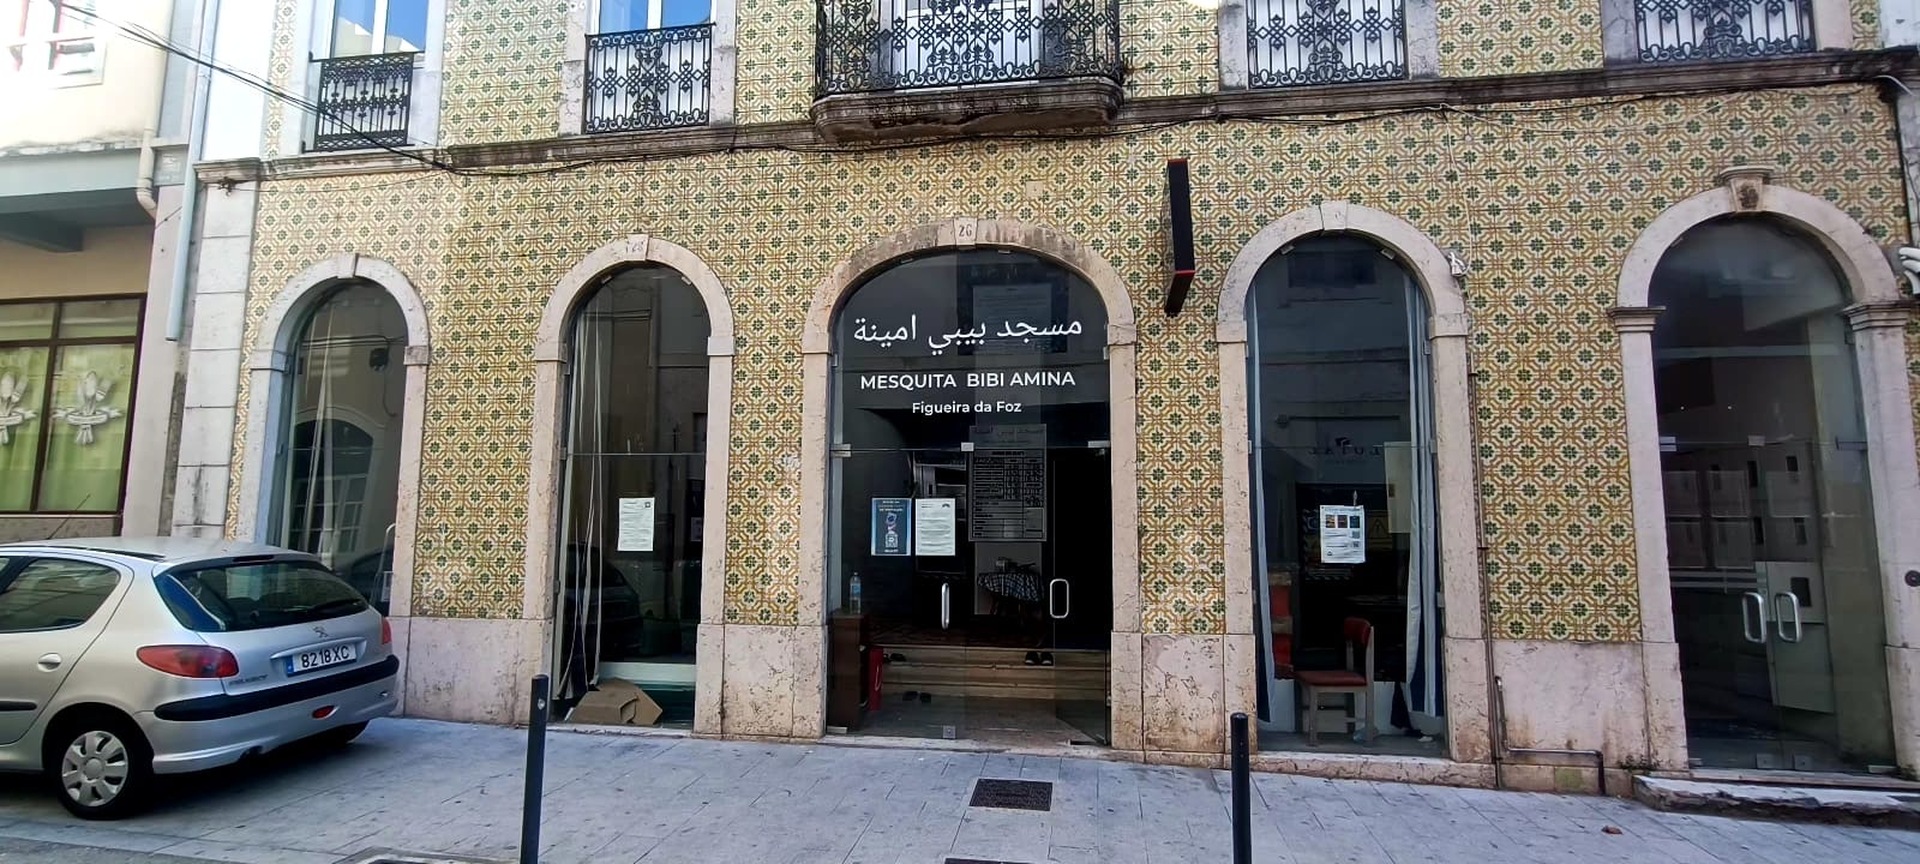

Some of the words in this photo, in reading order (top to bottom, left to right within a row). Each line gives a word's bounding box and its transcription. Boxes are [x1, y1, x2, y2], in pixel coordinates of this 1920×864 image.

[958, 223, 973, 237] 26
[853, 313, 917, 348] امينة
[928, 322, 986, 356] بيبي
[996, 320, 1082, 344] مسجد
[860, 373, 957, 391] MESQUITA
[966, 372, 1005, 388] BIBI
[1009, 371, 1076, 387] AMINA
[912, 400, 970, 416] Figueira
[974, 401, 992, 413] da
[996, 401, 1022, 413] Foz
